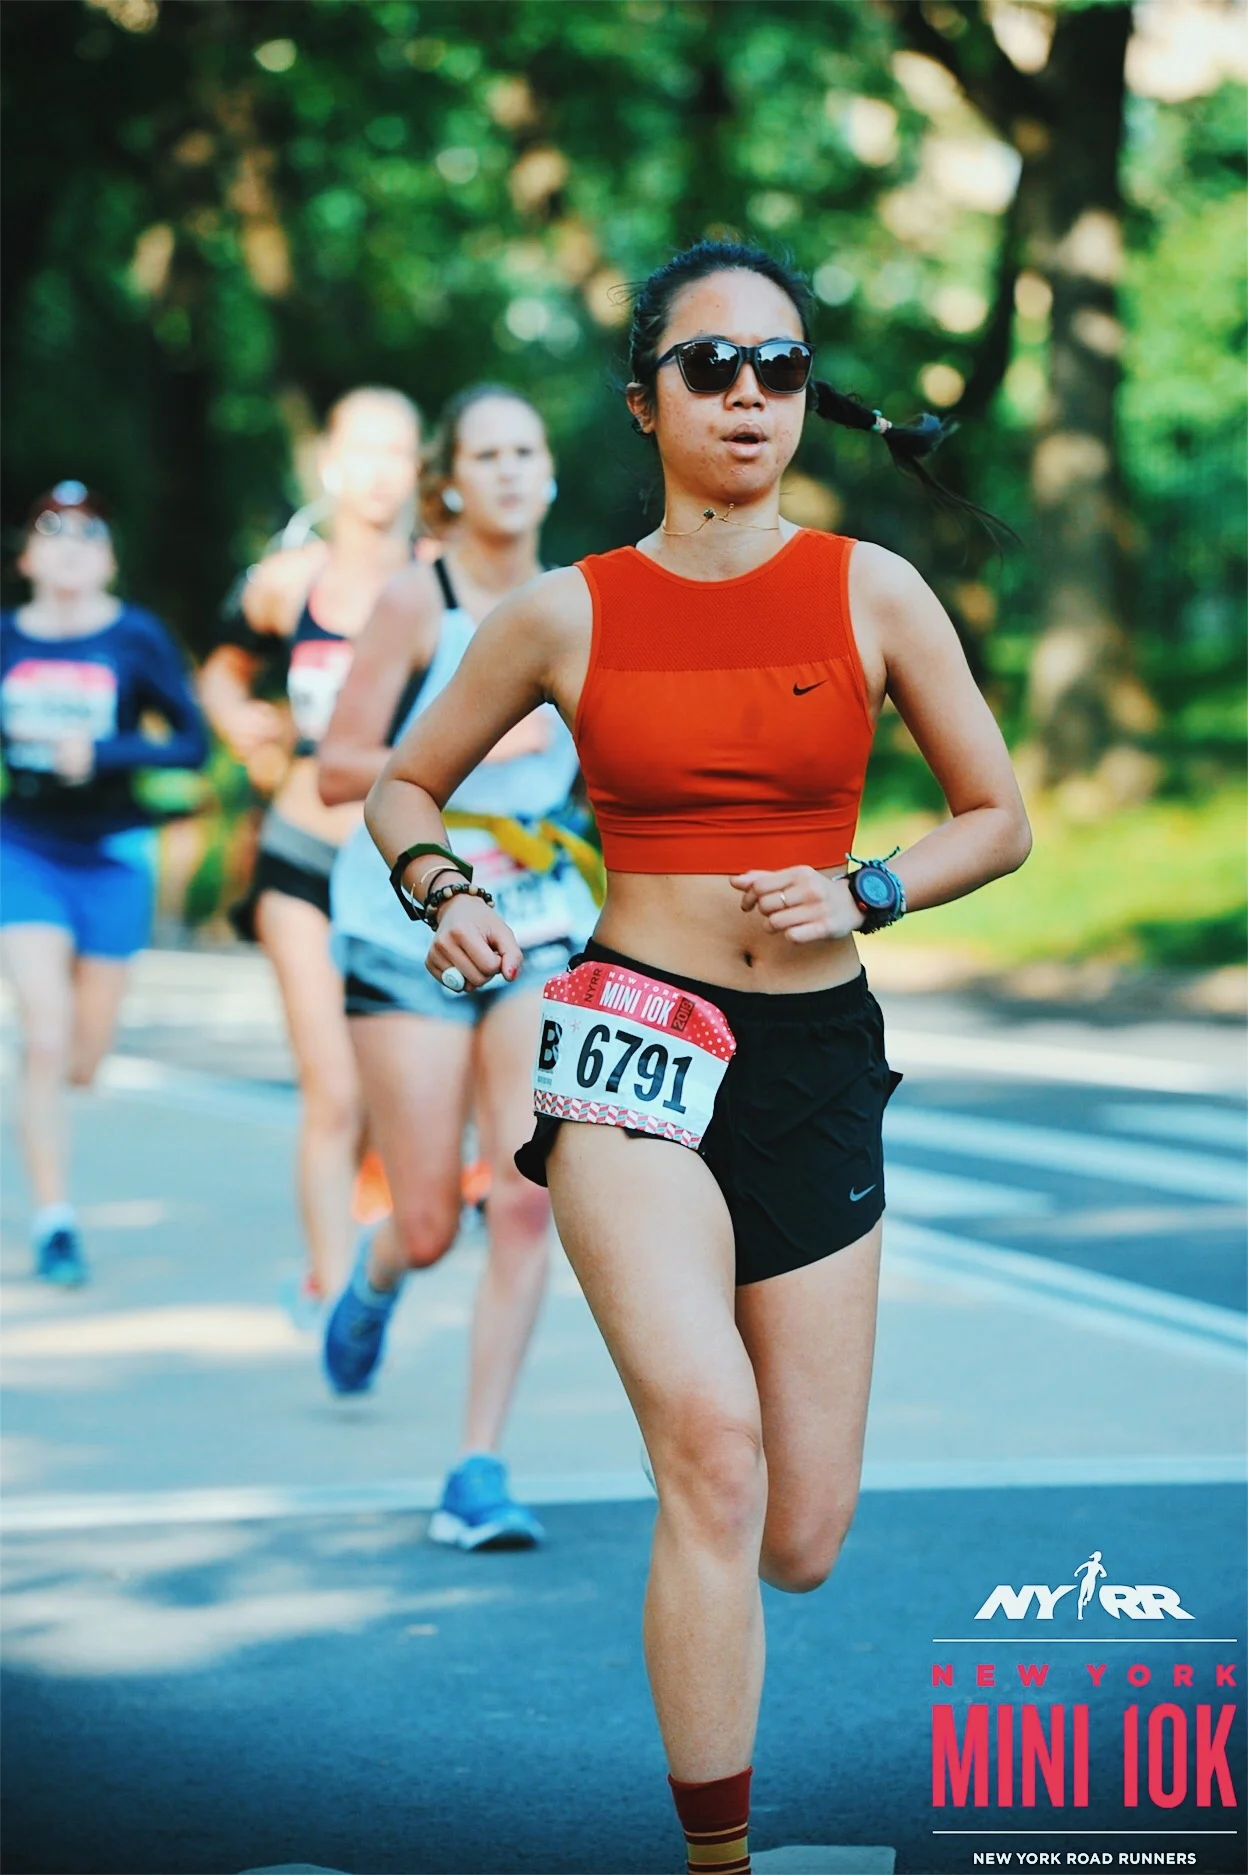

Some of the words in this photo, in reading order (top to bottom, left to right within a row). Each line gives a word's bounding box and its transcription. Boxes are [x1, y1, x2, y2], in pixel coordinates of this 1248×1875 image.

[584, 967, 603, 1003] NYRR
[599, 981, 642, 1014] MINI
[641, 994, 676, 1027] 10K
[609, 971, 637, 985] NEW
[644, 982, 680, 1000] YORK
[673, 1000, 694, 1031] 2018
[538, 1019, 563, 1070] B
[576, 1024, 693, 1115] 6791
